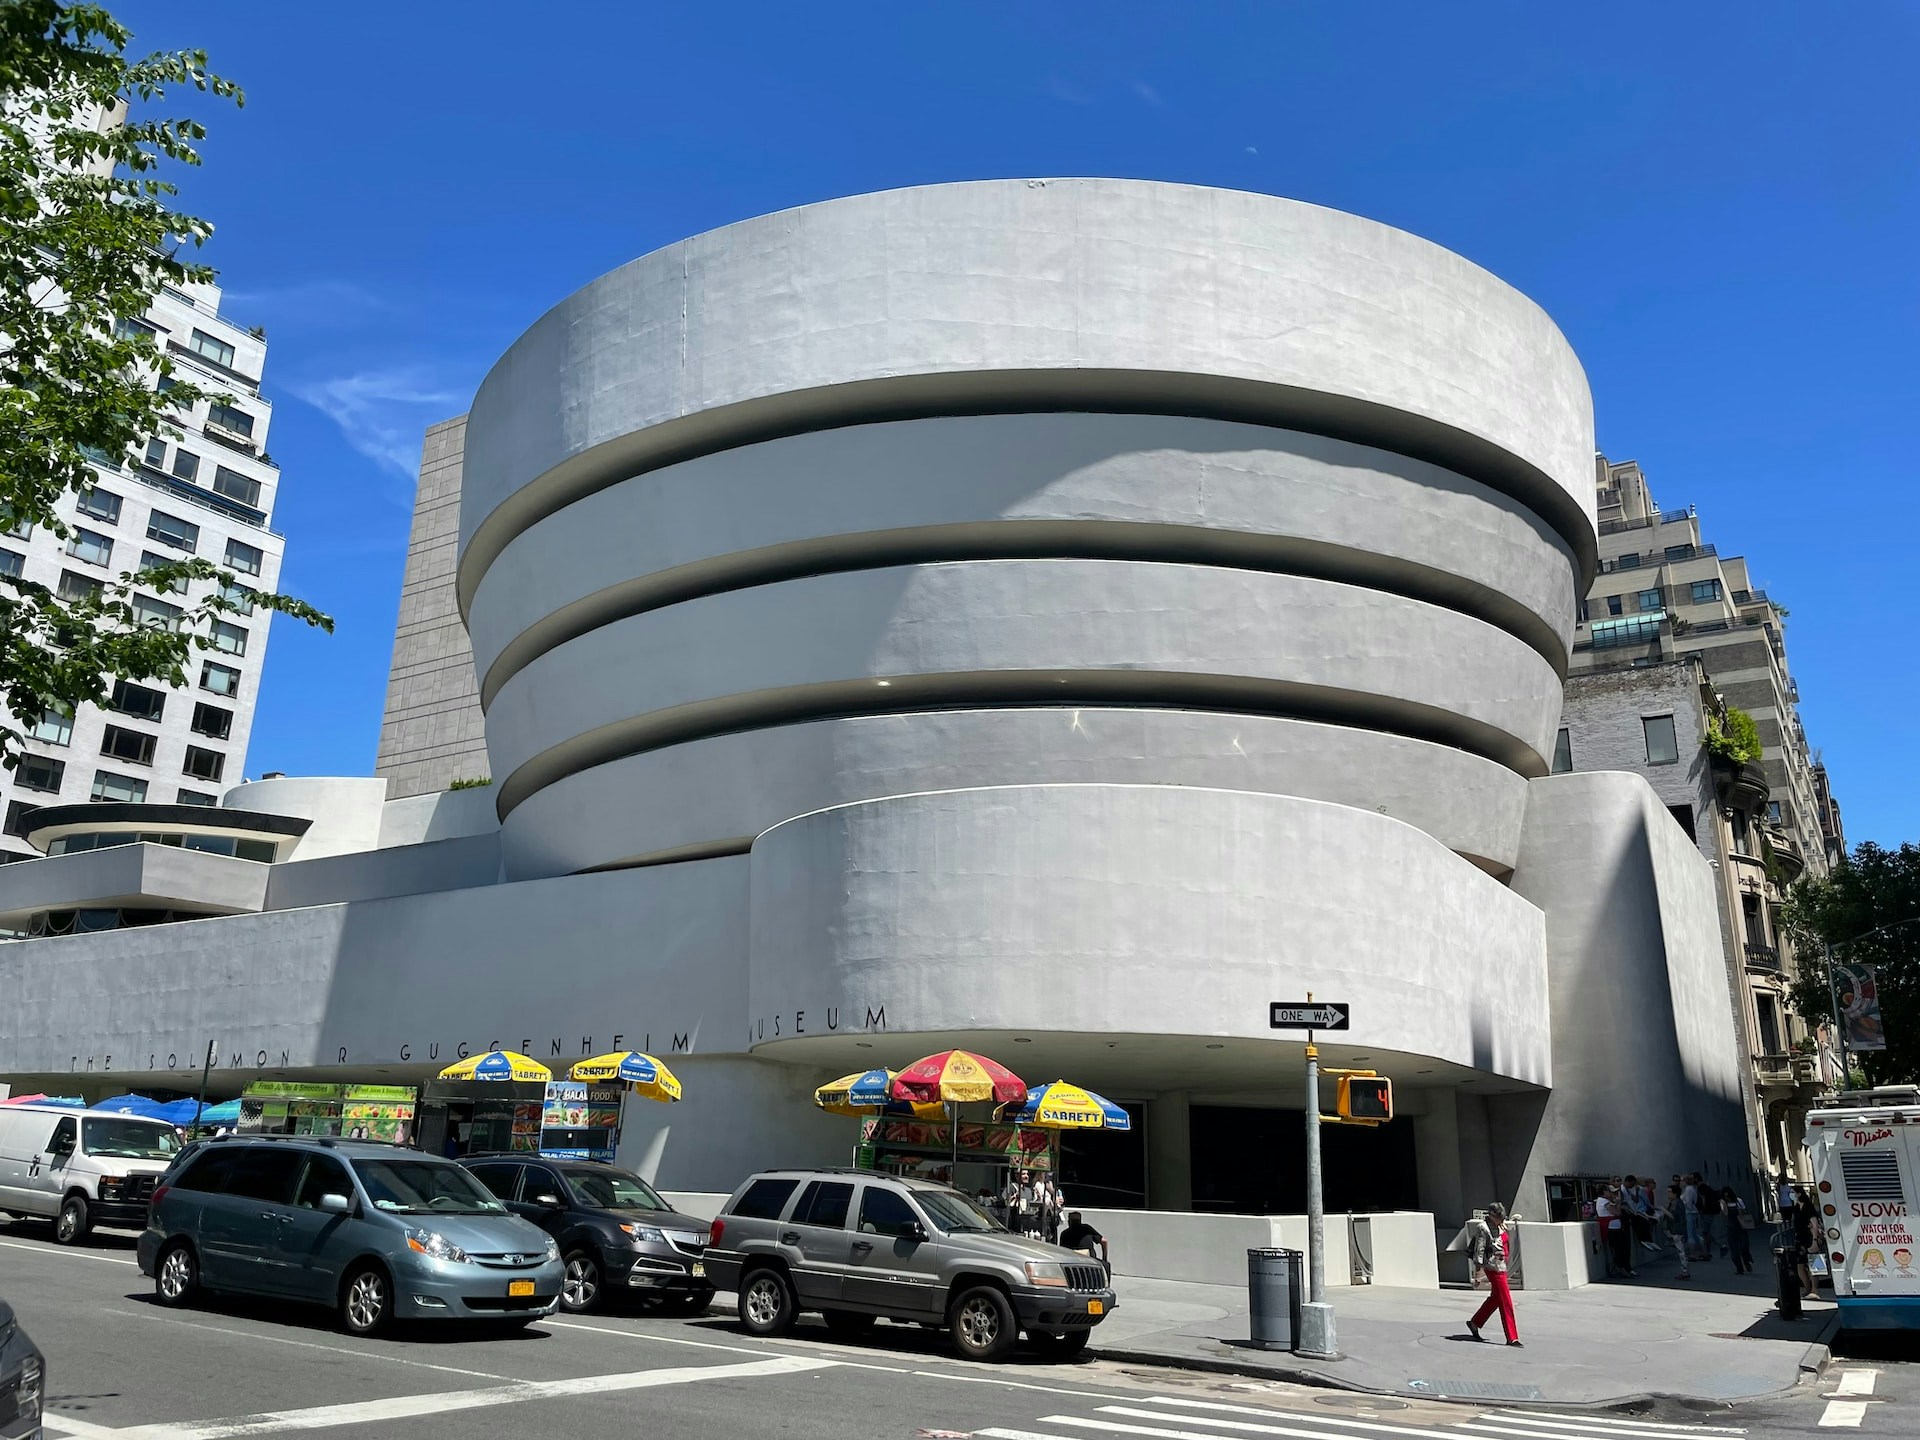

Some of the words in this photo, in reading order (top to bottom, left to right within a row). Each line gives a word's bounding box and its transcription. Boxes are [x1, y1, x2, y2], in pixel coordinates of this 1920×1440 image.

[1281, 1010, 1304, 1021] ONE
[1313, 1011, 1337, 1022] WAY
[71, 1055, 111, 1072] THE
[338, 1046, 347, 1063] R
[564, 1089, 588, 1100] HALAL
[590, 1091, 610, 1100] FOOD
[1377, 1089, 1389, 1112] 4
[1042, 1109, 1100, 1123] SABRETT
[1843, 1128, 1895, 1147] Mister
[1860, 1223, 1888, 1234] WATCH
[1889, 1223, 1906, 1234] FOR
[1856, 1235, 1874, 1245] OUR
[1875, 1234, 1914, 1245] CHILDREN
